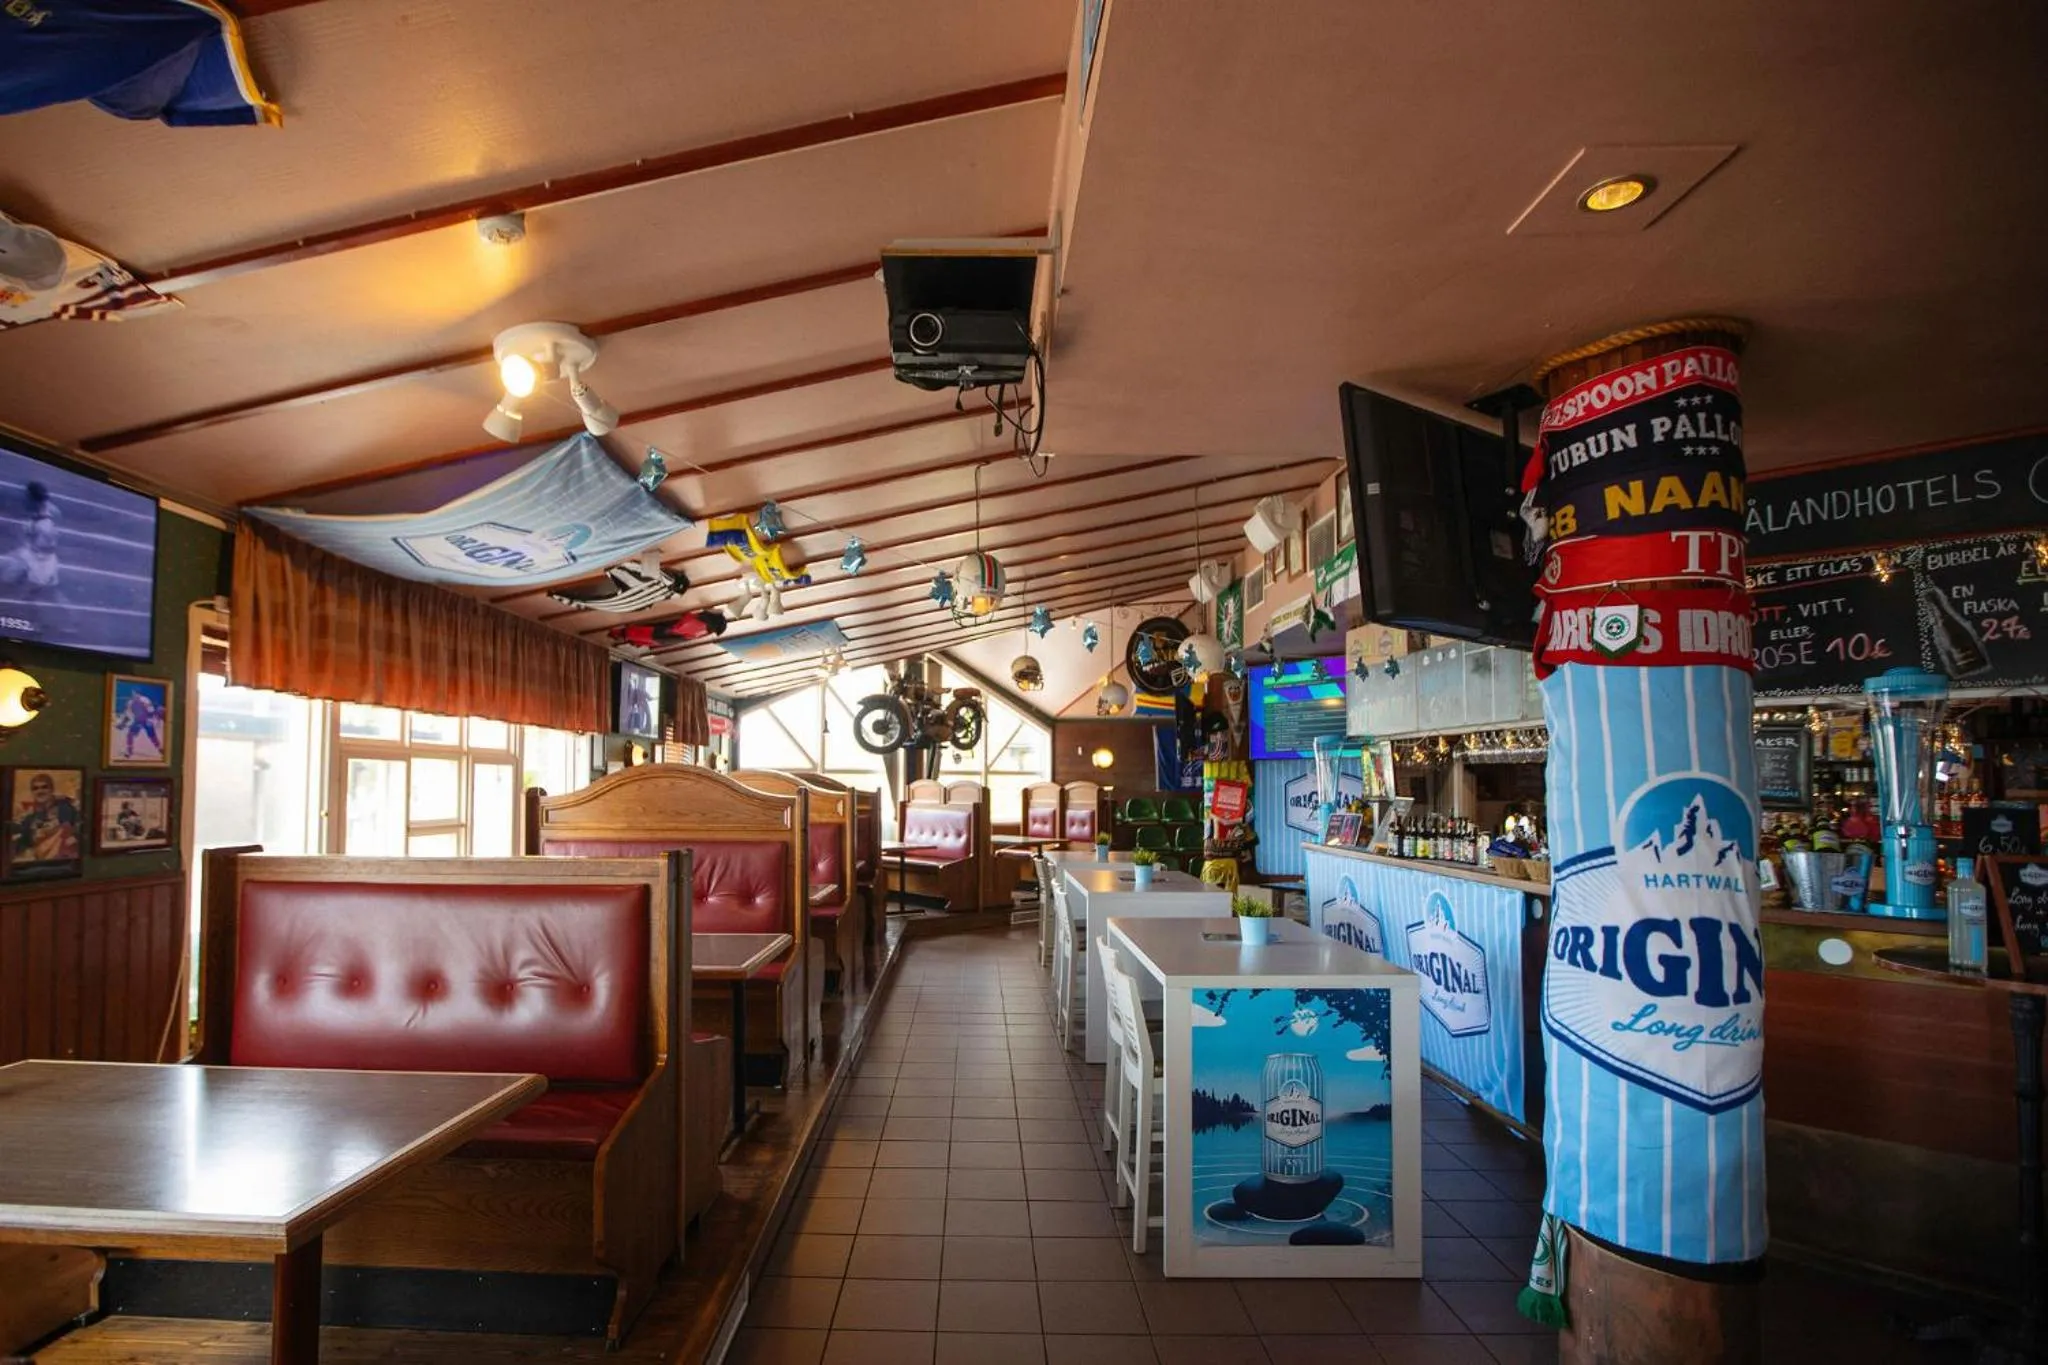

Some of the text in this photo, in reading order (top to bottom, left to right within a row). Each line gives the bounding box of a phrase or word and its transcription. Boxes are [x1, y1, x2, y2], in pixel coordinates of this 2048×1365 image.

[1745, 470, 2001, 534] ÅLANDHOTELS
[1671, 531, 1748, 576] TP
[1927, 546, 1991, 570] BUBBEL
[1786, 564, 1816, 581] ETT
[1818, 556, 1864, 576] GLAS
[1951, 583, 1975, 599] EN
[1963, 598, 2020, 616] FLASKA
[1414, 951, 1481, 995] ORIGINAL
[1611, 1003, 1704, 1051] Long
[1267, 1108, 1321, 1128] ORIGINAL
